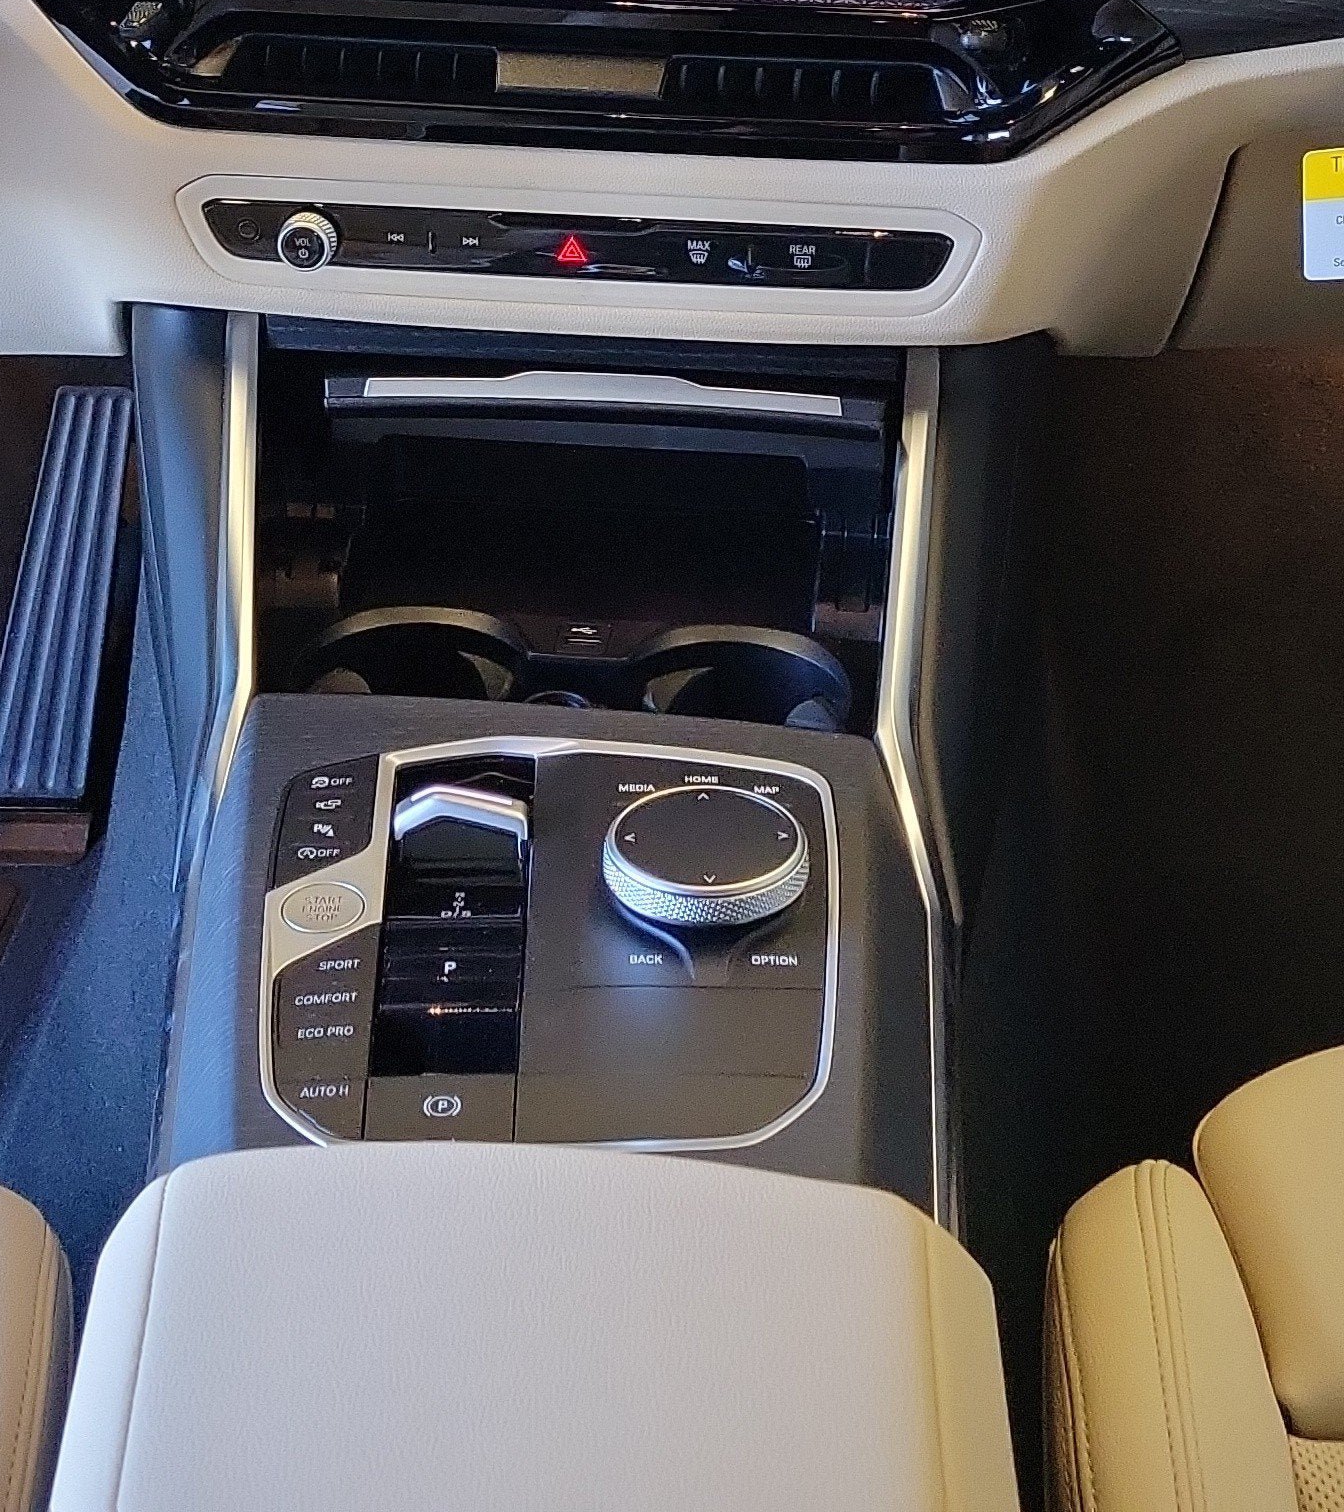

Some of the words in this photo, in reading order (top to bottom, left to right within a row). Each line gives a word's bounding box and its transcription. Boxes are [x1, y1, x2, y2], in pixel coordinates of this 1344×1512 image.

[295, 237, 311, 247] VOL
[687, 239, 711, 251] MAX
[789, 244, 816, 255] REAR
[330, 777, 353, 786] OFF
[684, 774, 719, 784] HOME
[618, 783, 656, 793] MEDIA
[754, 785, 780, 795] MAP
[317, 848, 341, 858] OFF
[319, 958, 361, 971] SPORT
[629, 954, 663, 965] BACK
[751, 954, 798, 966] OPTION
[444, 961, 457, 975] P
[294, 991, 358, 1006] COMFORT
[297, 1026, 324, 1039] ECO
[327, 1025, 354, 1037] PRO
[299, 1085, 337, 1099] AUTO
[339, 1084, 349, 1097] H
